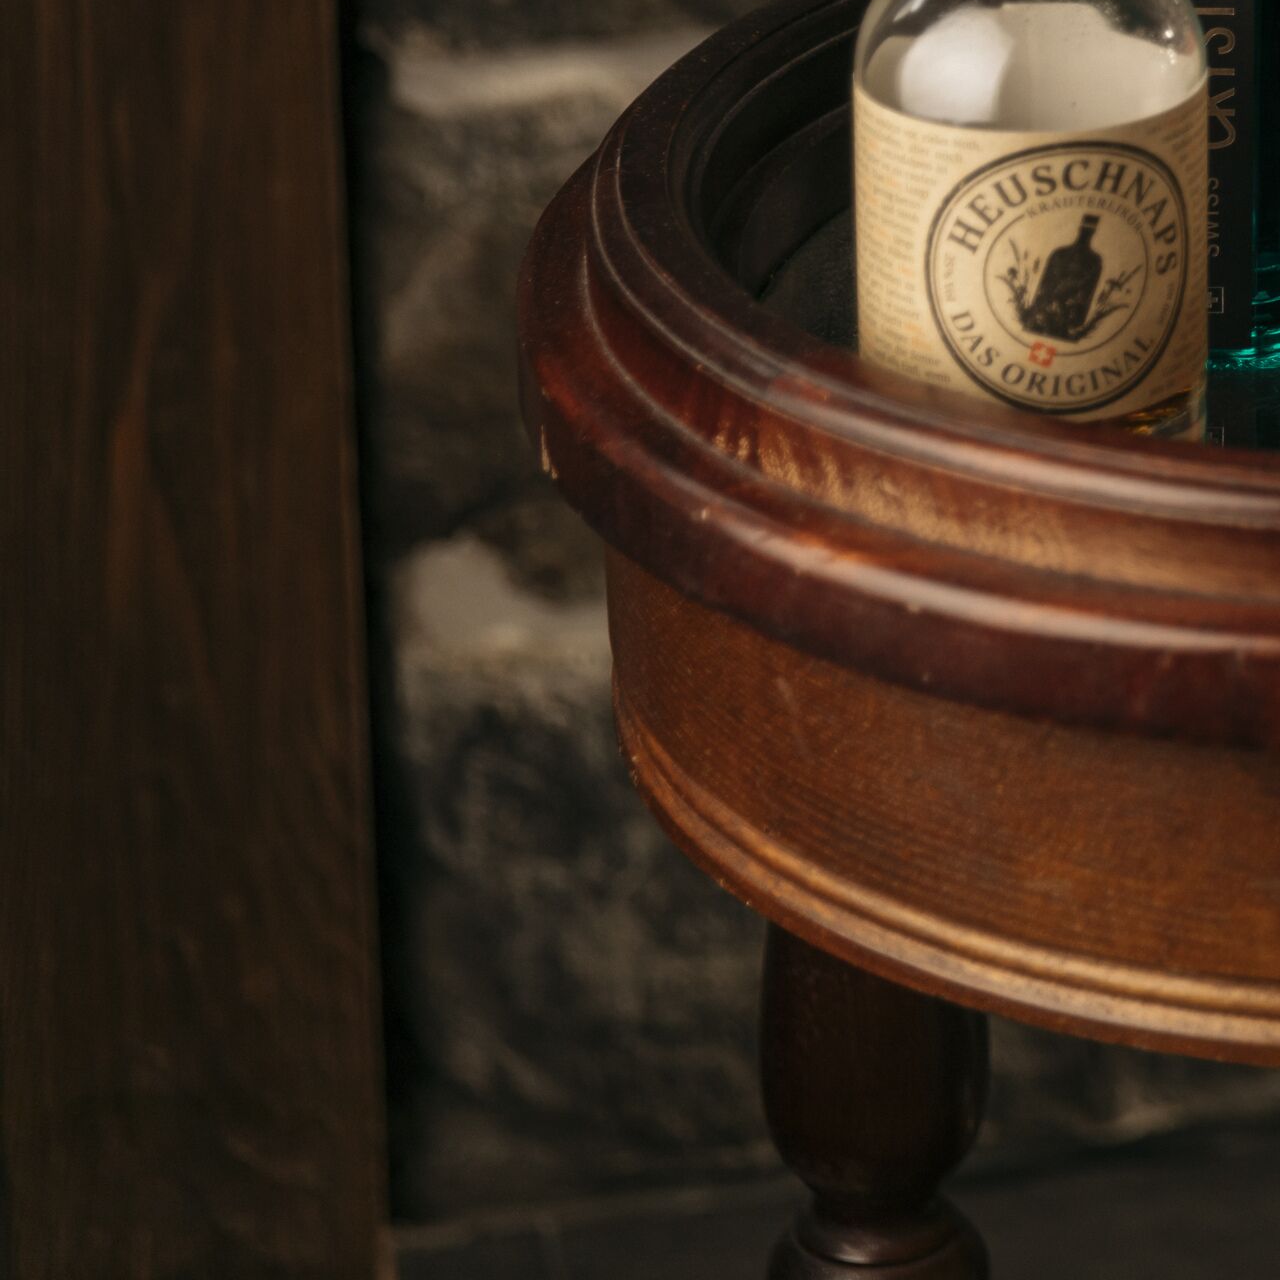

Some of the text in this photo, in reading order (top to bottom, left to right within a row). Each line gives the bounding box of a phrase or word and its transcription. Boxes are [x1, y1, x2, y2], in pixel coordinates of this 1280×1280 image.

[948, 158, 1179, 277] HEUSCHNAPS
[951, 309, 1156, 399] DAS ORIGINAL
